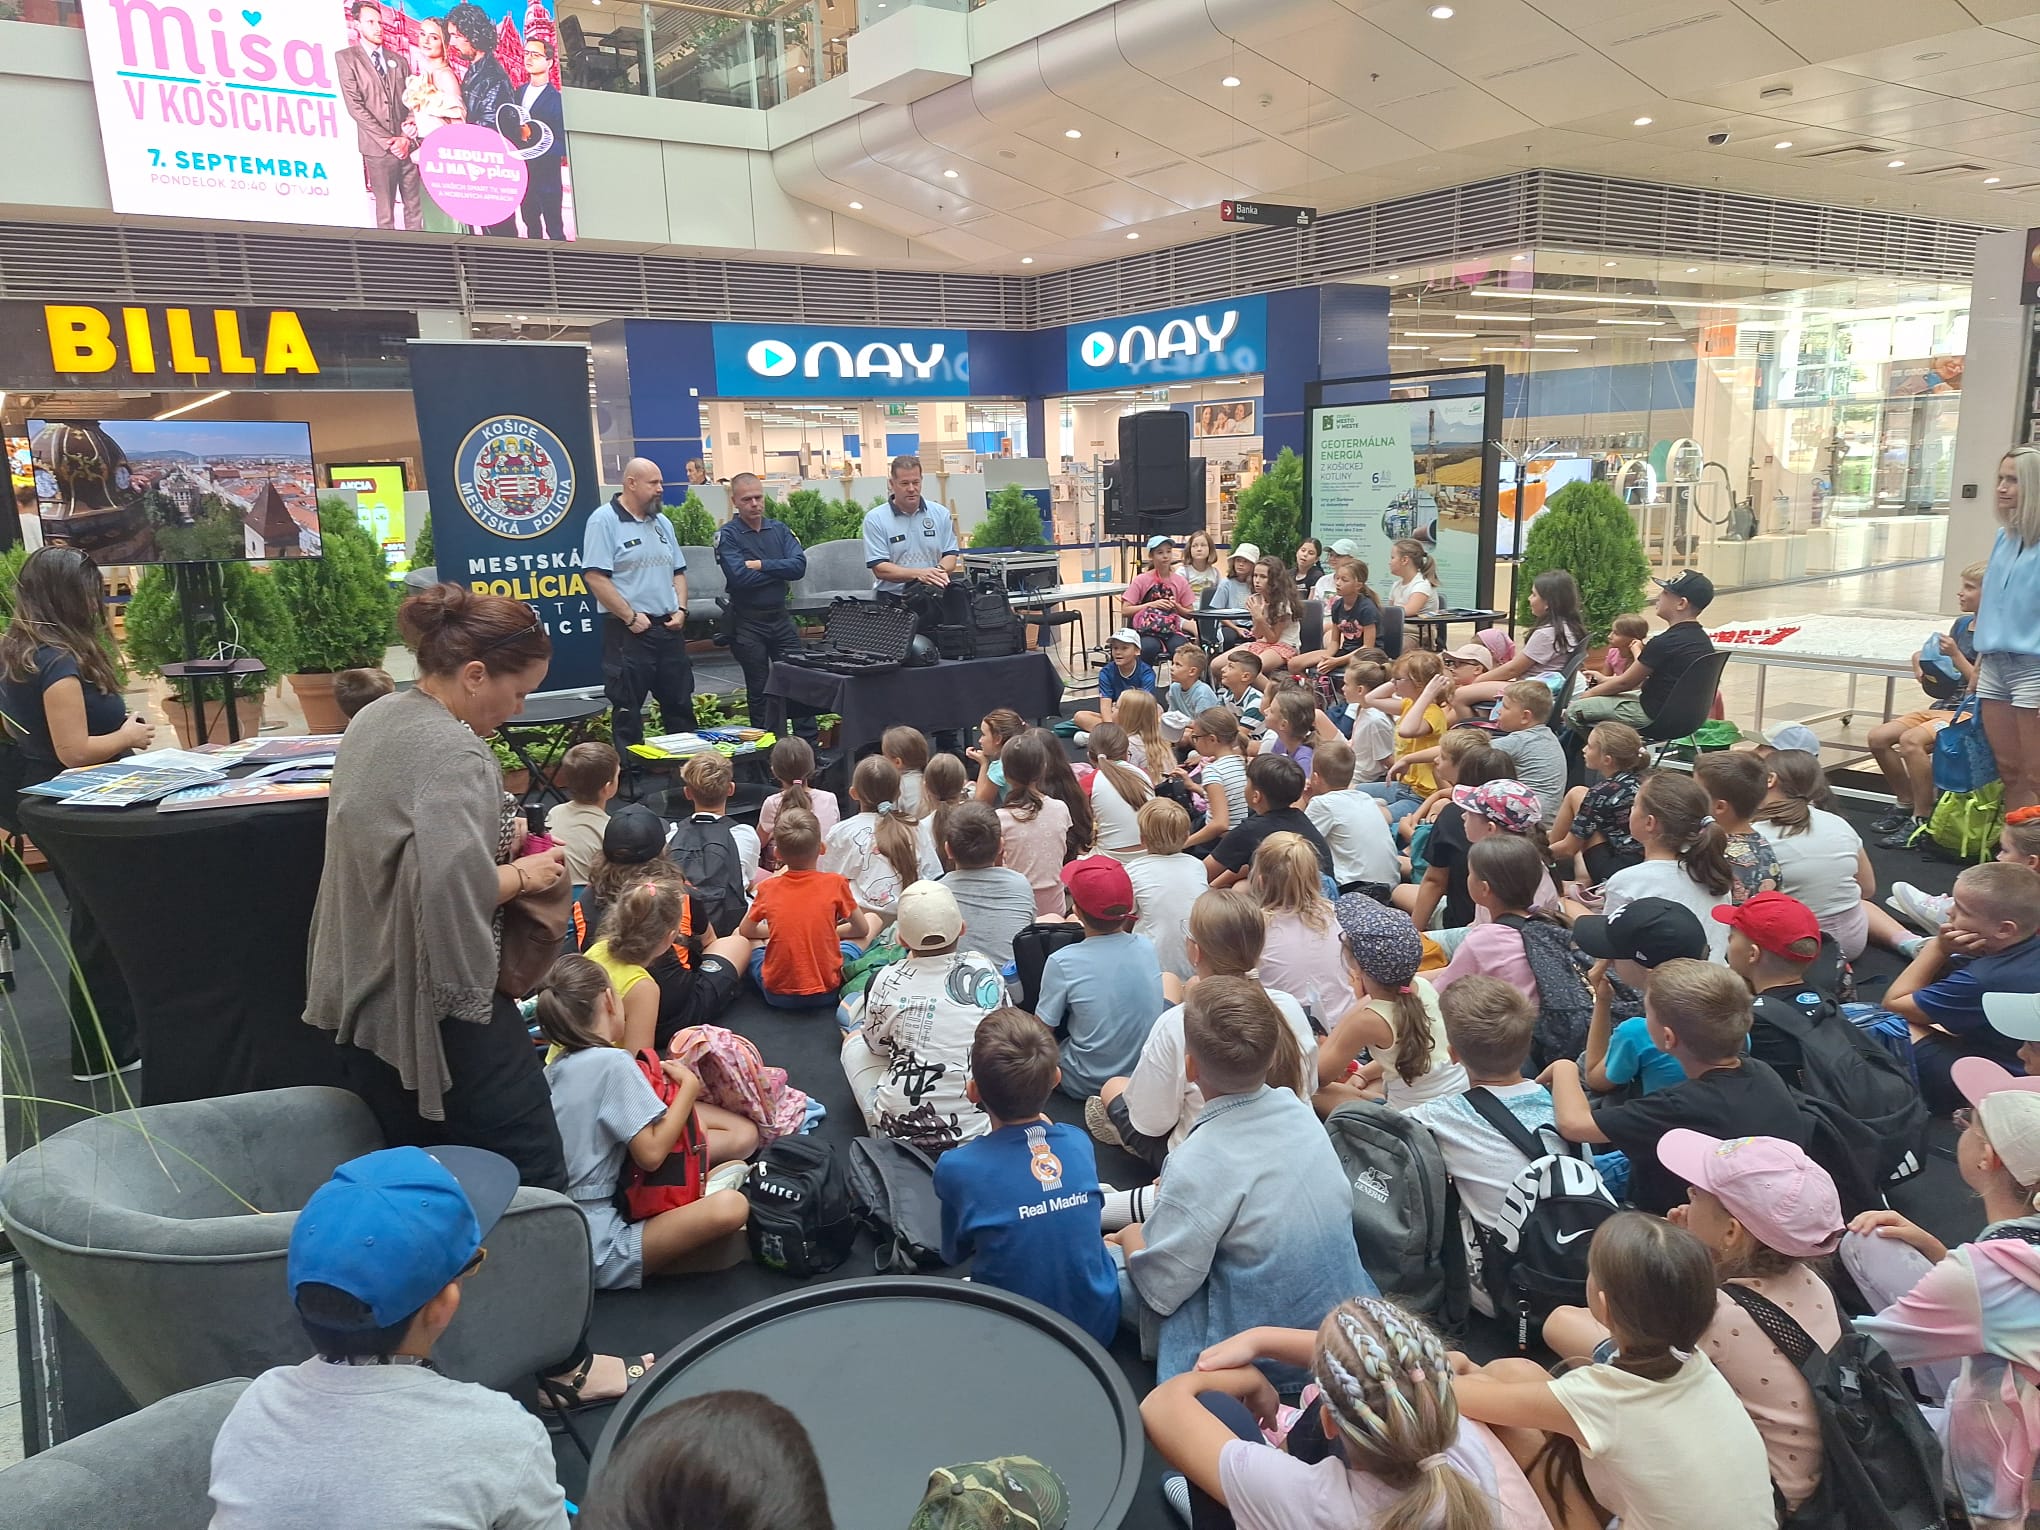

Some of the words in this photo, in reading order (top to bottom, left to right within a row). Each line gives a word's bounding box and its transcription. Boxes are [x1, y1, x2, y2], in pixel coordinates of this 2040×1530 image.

[123, 80, 145, 120] V
[158, 80, 339, 138] KOŠICIACH
[147, 148, 166, 168] 7.
[175, 150, 328, 180] SEPTEMBRA
[487, 166, 520, 181] play
[151, 173, 225, 189] PONDELOK
[230, 179, 267, 191] 20:40
[1236, 204, 1258, 215] Banka
[44, 305, 320, 374] BILLA
[481, 419, 539, 440] KOŠICE
[1321, 436, 1396, 449] GEOTERMÁLNA
[1321, 450, 1363, 461] ENERGIA
[1320, 463, 1326, 471] Z
[1326, 462, 1364, 471] KOŠICKEJ
[1320, 472, 1352, 481] KOTLINY
[1372, 473, 1379, 484] 6
[460, 481, 520, 535] MESTSKÁ
[533, 479, 572, 531] POLÍCIA
[469, 549, 582, 575] MESTSKÁ
[471, 571, 588, 600] POLÍCIA
[759, 1181, 801, 1202] MATEJ
[1354, 1181, 1390, 1204] GENERALI
[1018, 1203, 1047, 1219] Real
[1050, 1192, 1088, 1213] Madrid
